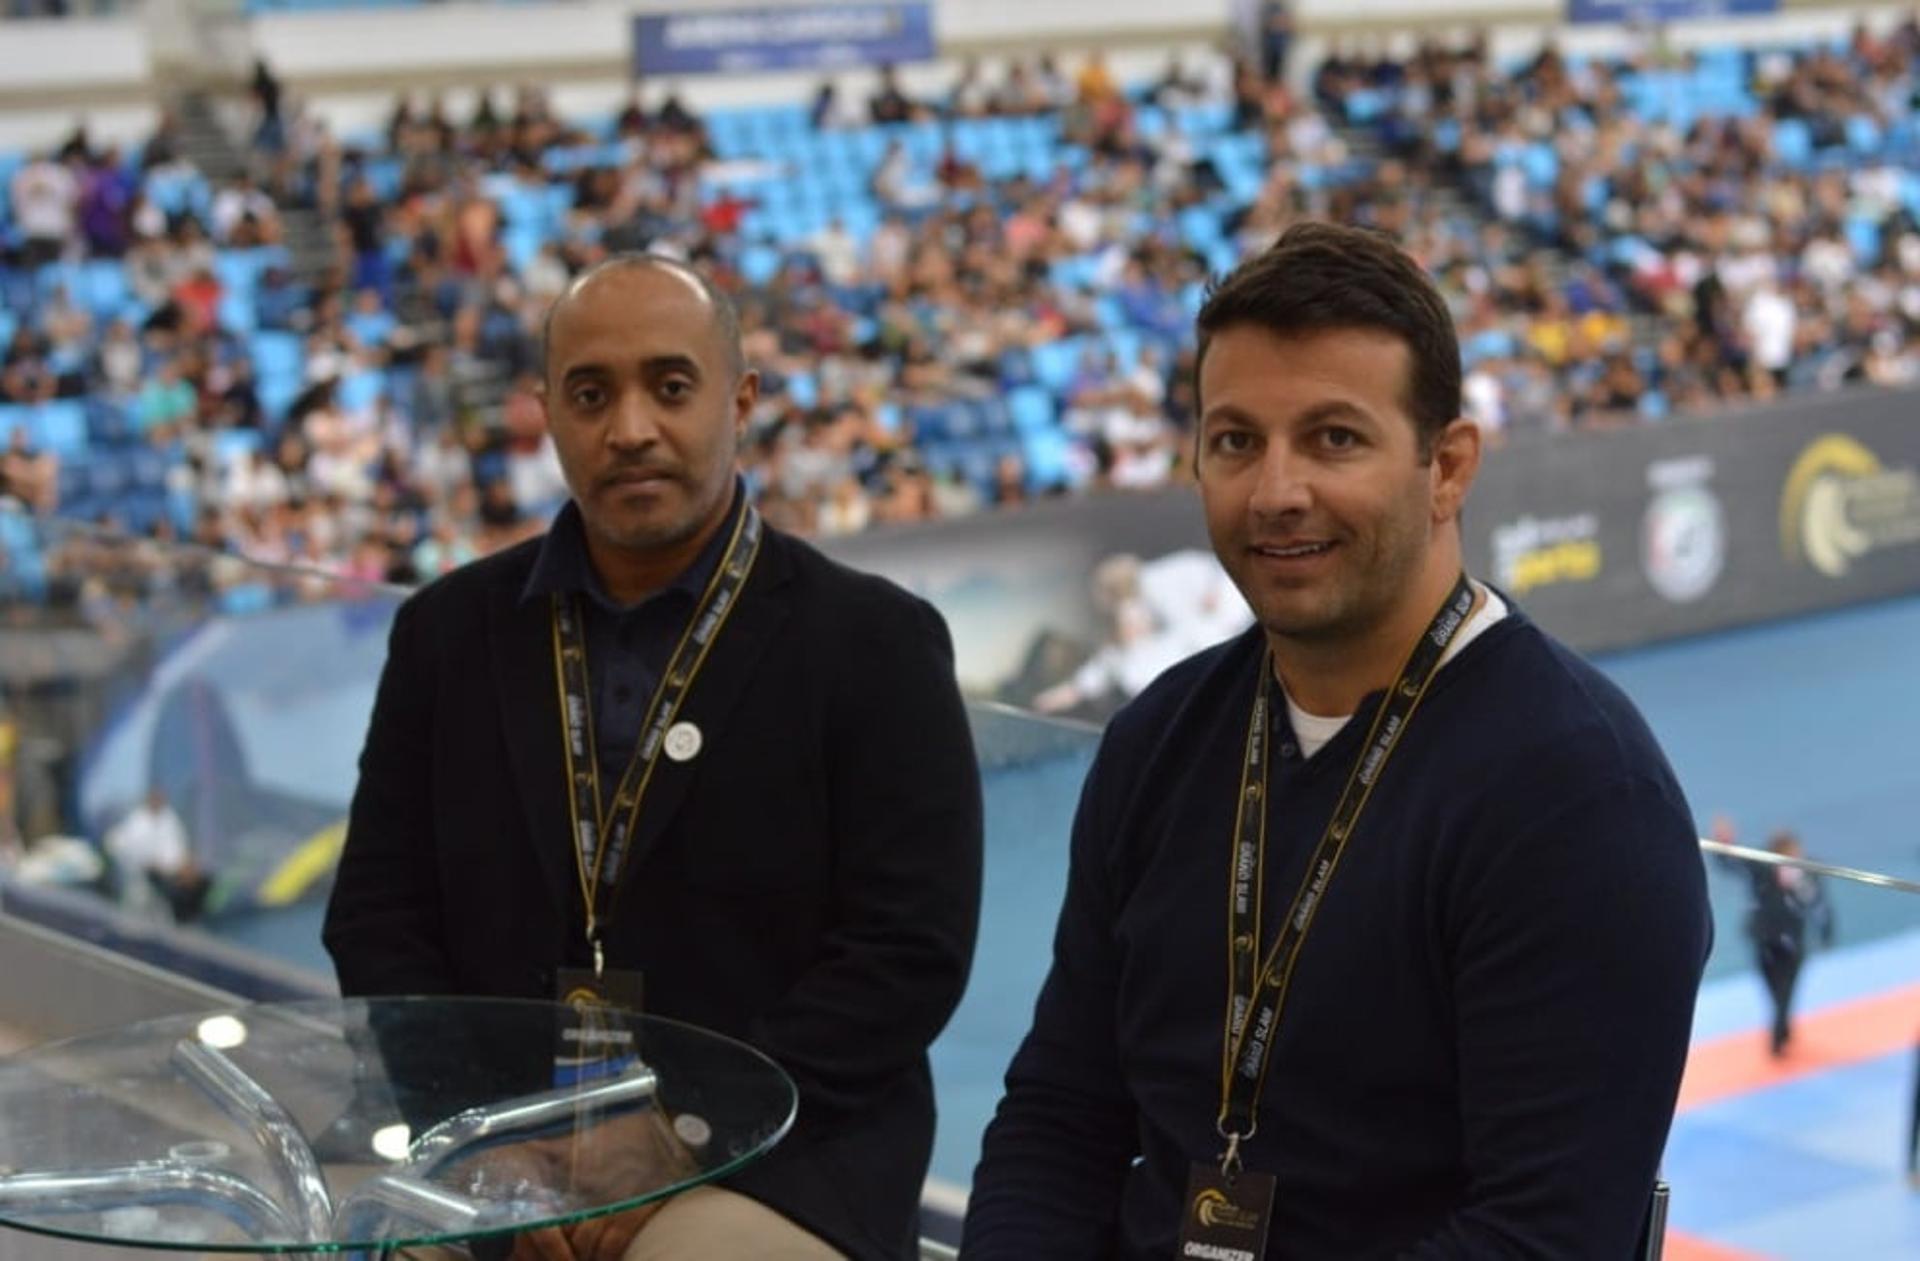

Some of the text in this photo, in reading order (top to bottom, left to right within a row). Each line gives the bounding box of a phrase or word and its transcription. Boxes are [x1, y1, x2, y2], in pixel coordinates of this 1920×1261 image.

[1379, 714, 1401, 746] SLAM
[1254, 1006, 1273, 1041] SLAM
[1183, 1240, 1255, 1261] ORGANIZER
